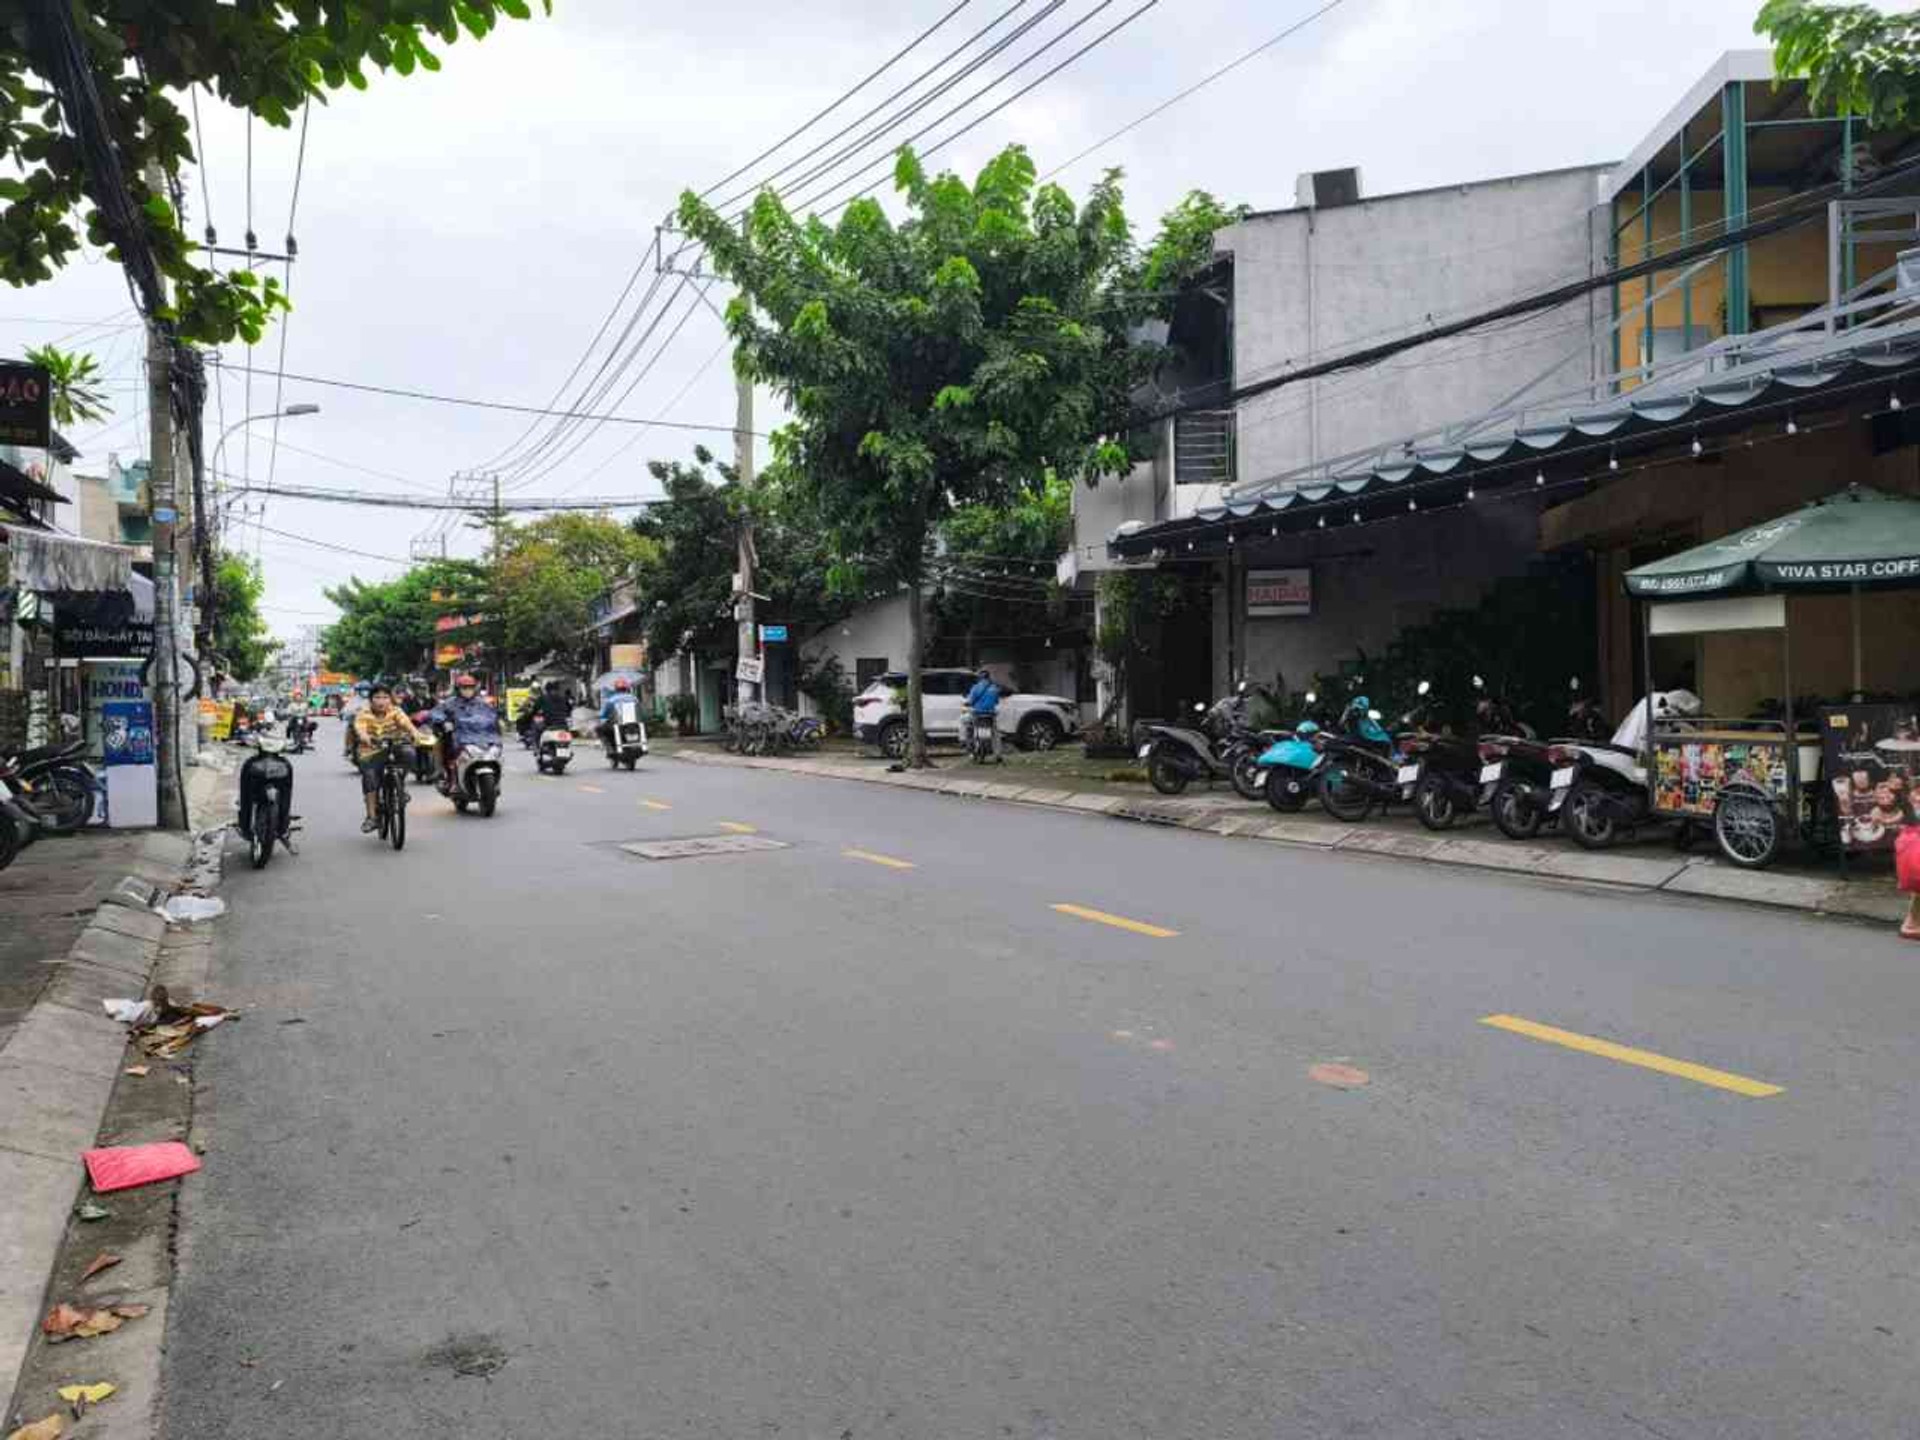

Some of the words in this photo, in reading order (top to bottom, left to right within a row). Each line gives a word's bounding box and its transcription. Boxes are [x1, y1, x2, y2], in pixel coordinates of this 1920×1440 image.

[1777, 565, 1816, 578] VIVA
[1821, 563, 1867, 578] STAR
[1871, 560, 1920, 576] COFF
